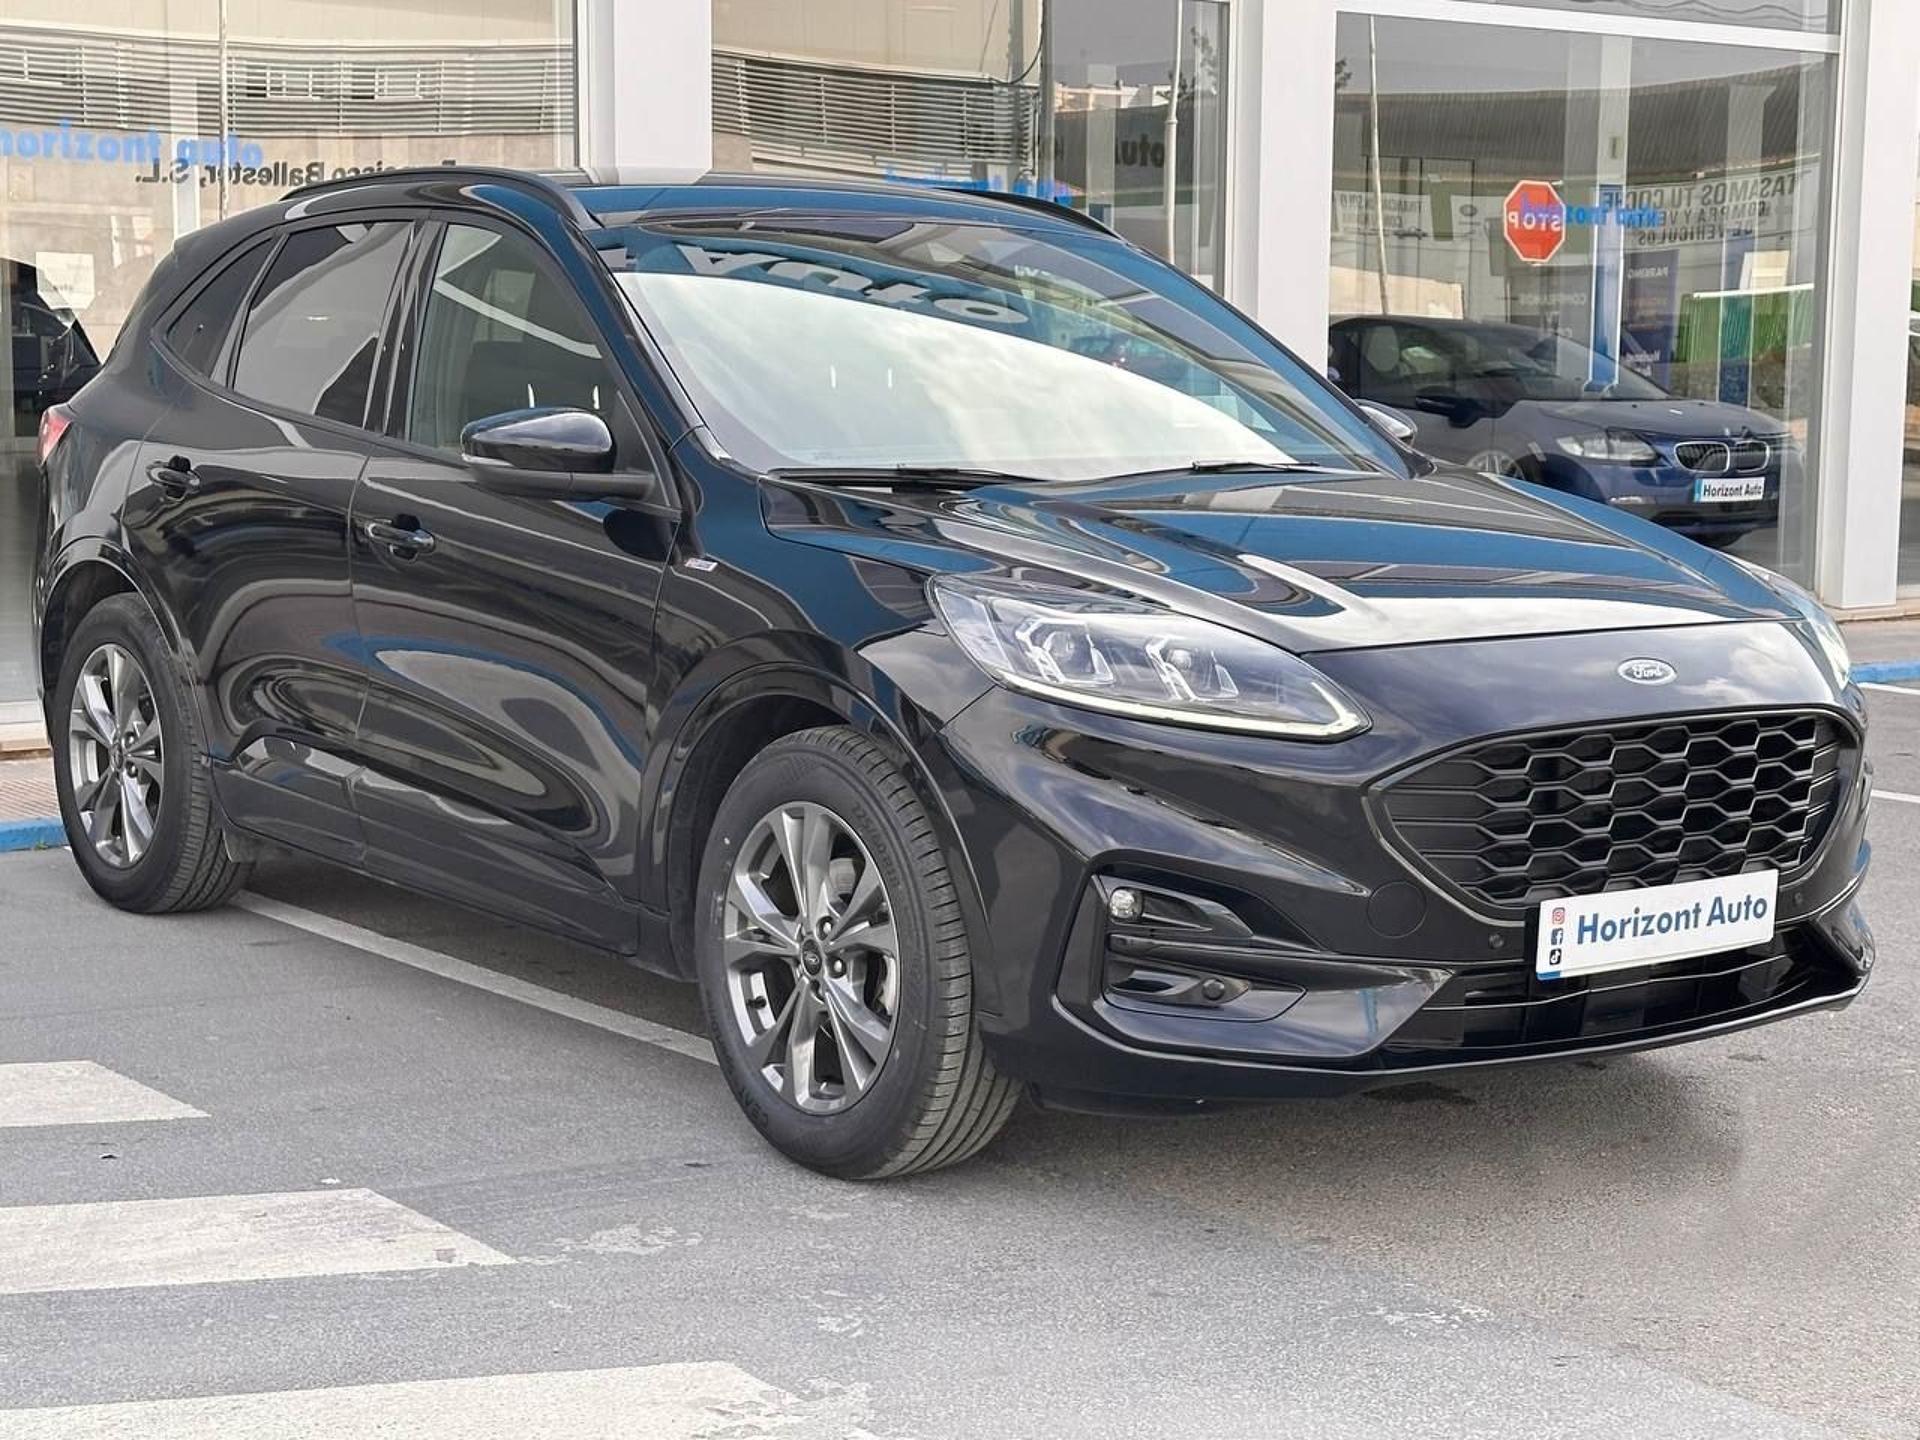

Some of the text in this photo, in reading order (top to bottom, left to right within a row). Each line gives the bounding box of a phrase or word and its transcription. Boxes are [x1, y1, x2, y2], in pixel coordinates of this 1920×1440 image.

[1115, 133, 1165, 168] uto
[1703, 482, 1762, 497] Horizont Auto
[1577, 894, 1768, 945] Horizont Auto
